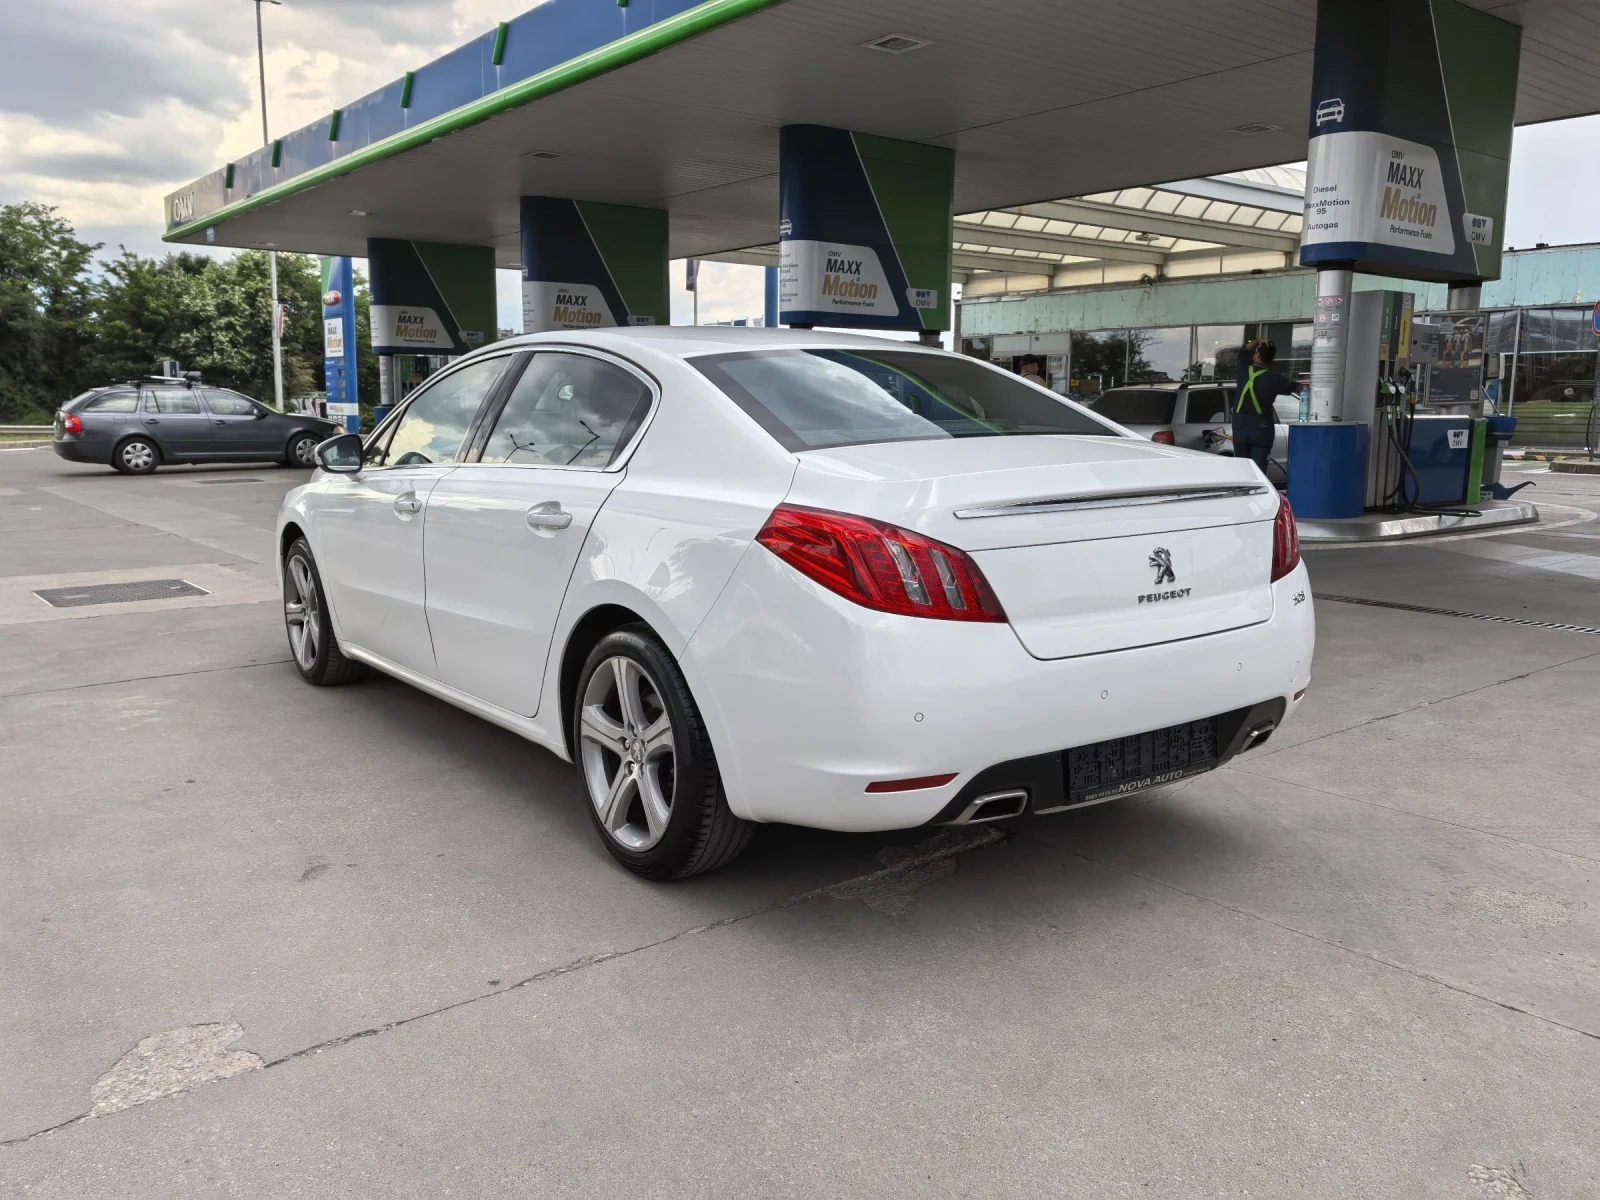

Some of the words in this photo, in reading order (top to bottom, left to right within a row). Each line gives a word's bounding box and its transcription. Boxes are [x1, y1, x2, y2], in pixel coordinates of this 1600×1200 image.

[1392, 150, 1405, 160] OMV
[1387, 161, 1424, 189] MAXX
[1313, 184, 1337, 194] Diesel
[1316, 207, 1327, 215] 95
[1380, 186, 1437, 228] Motion
[1307, 222, 1339, 231] Autogas
[1389, 224, 1419, 238] Performance
[1420, 229, 1432, 240] Fuels
[1471, 231, 1486, 242] OMV
[826, 258, 862, 275] MAXX
[822, 274, 878, 299] Motion
[555, 294, 587, 307] MAXX
[831, 298, 862, 306] Performance
[862, 300, 875, 308] Fuels
[915, 299, 931, 307] OMV
[397, 315, 425, 325] MAXX
[553, 306, 602, 324] Motion
[395, 325, 437, 338] Motion
[1137, 587, 1192, 605] PEUGEOT
[1118, 778, 1151, 792] NOVA
[1153, 770, 1183, 784] AUTO
